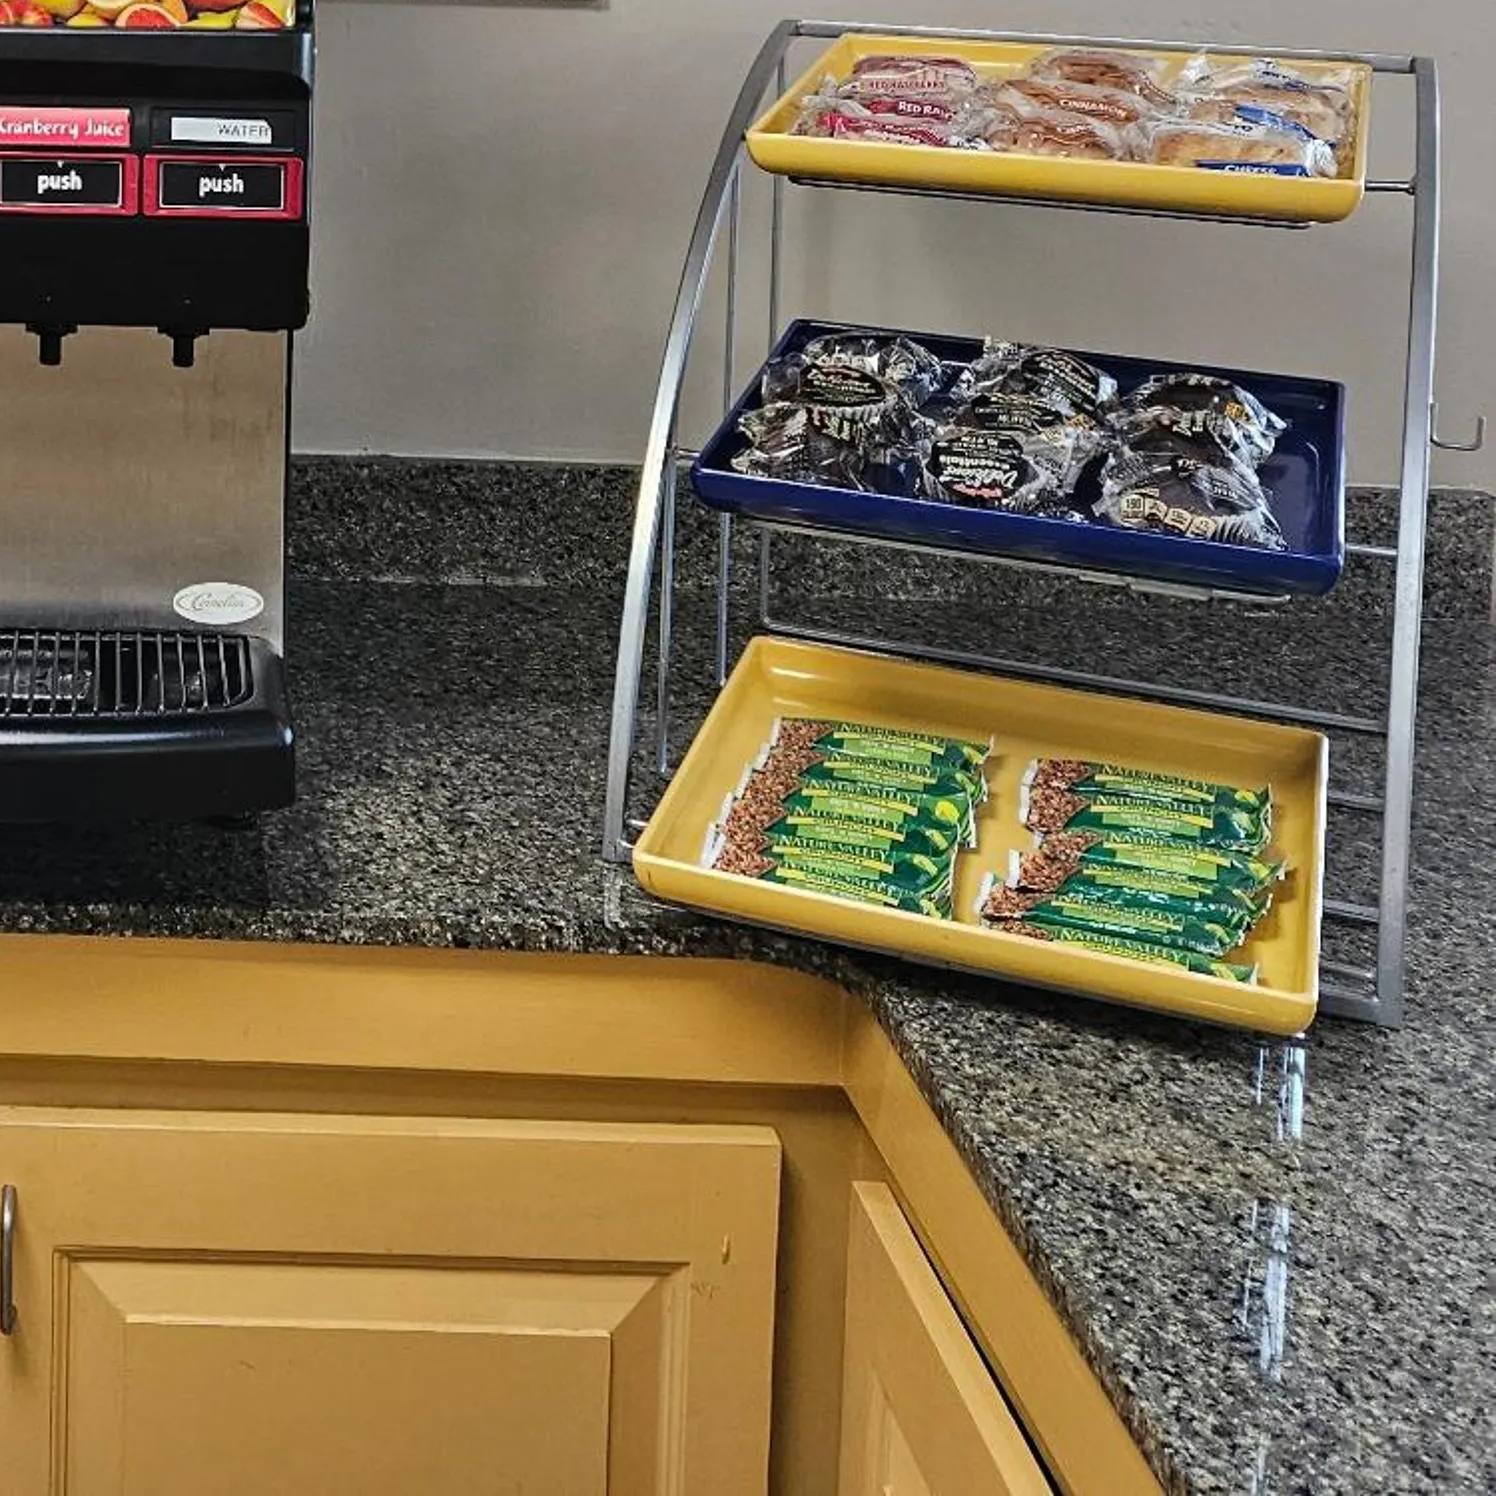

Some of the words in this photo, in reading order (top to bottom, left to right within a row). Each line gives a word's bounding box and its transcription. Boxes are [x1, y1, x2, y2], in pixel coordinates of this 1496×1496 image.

[85, 117, 124, 137] Juice
[217, 123, 270, 137] WATER
[38, 170, 82, 194] push
[199, 173, 244, 197] push
